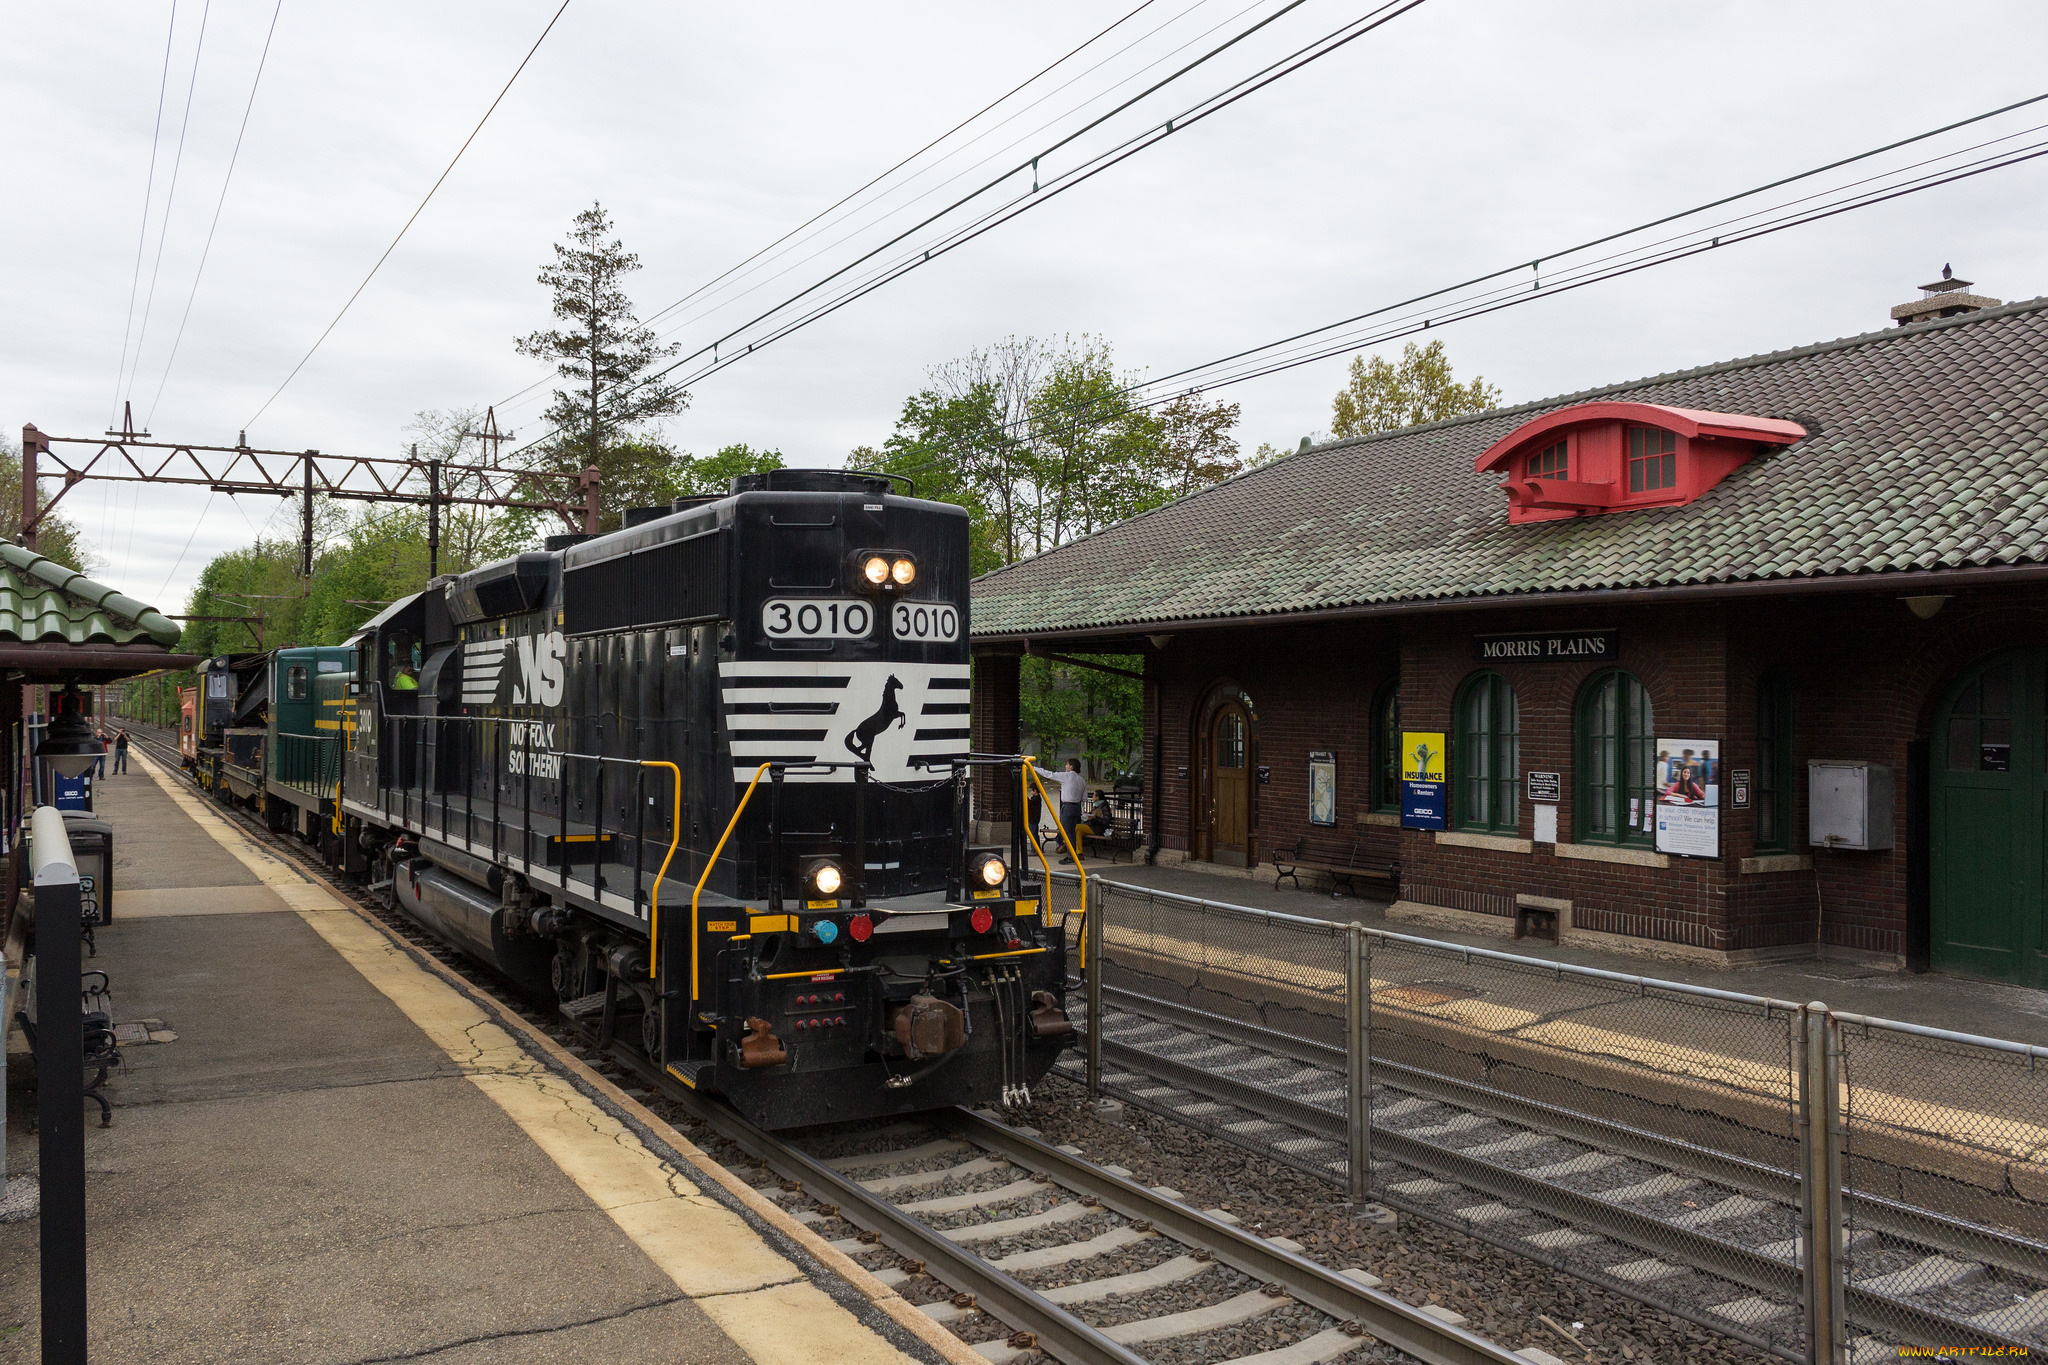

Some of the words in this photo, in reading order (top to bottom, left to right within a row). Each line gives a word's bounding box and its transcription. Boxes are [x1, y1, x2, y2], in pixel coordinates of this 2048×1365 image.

[768, 603, 868, 635] 3010
[896, 606, 956, 638] 3010
[1483, 640, 1540, 657] MORRIS
[1548, 638, 1605, 655] PLAINS
[513, 632, 566, 707] NS
[360, 709, 372, 732] 3010
[510, 723, 556, 748] NOFOLK
[1405, 771, 1442, 780] INSURANCE
[1704, 817, 1715, 825] help.
